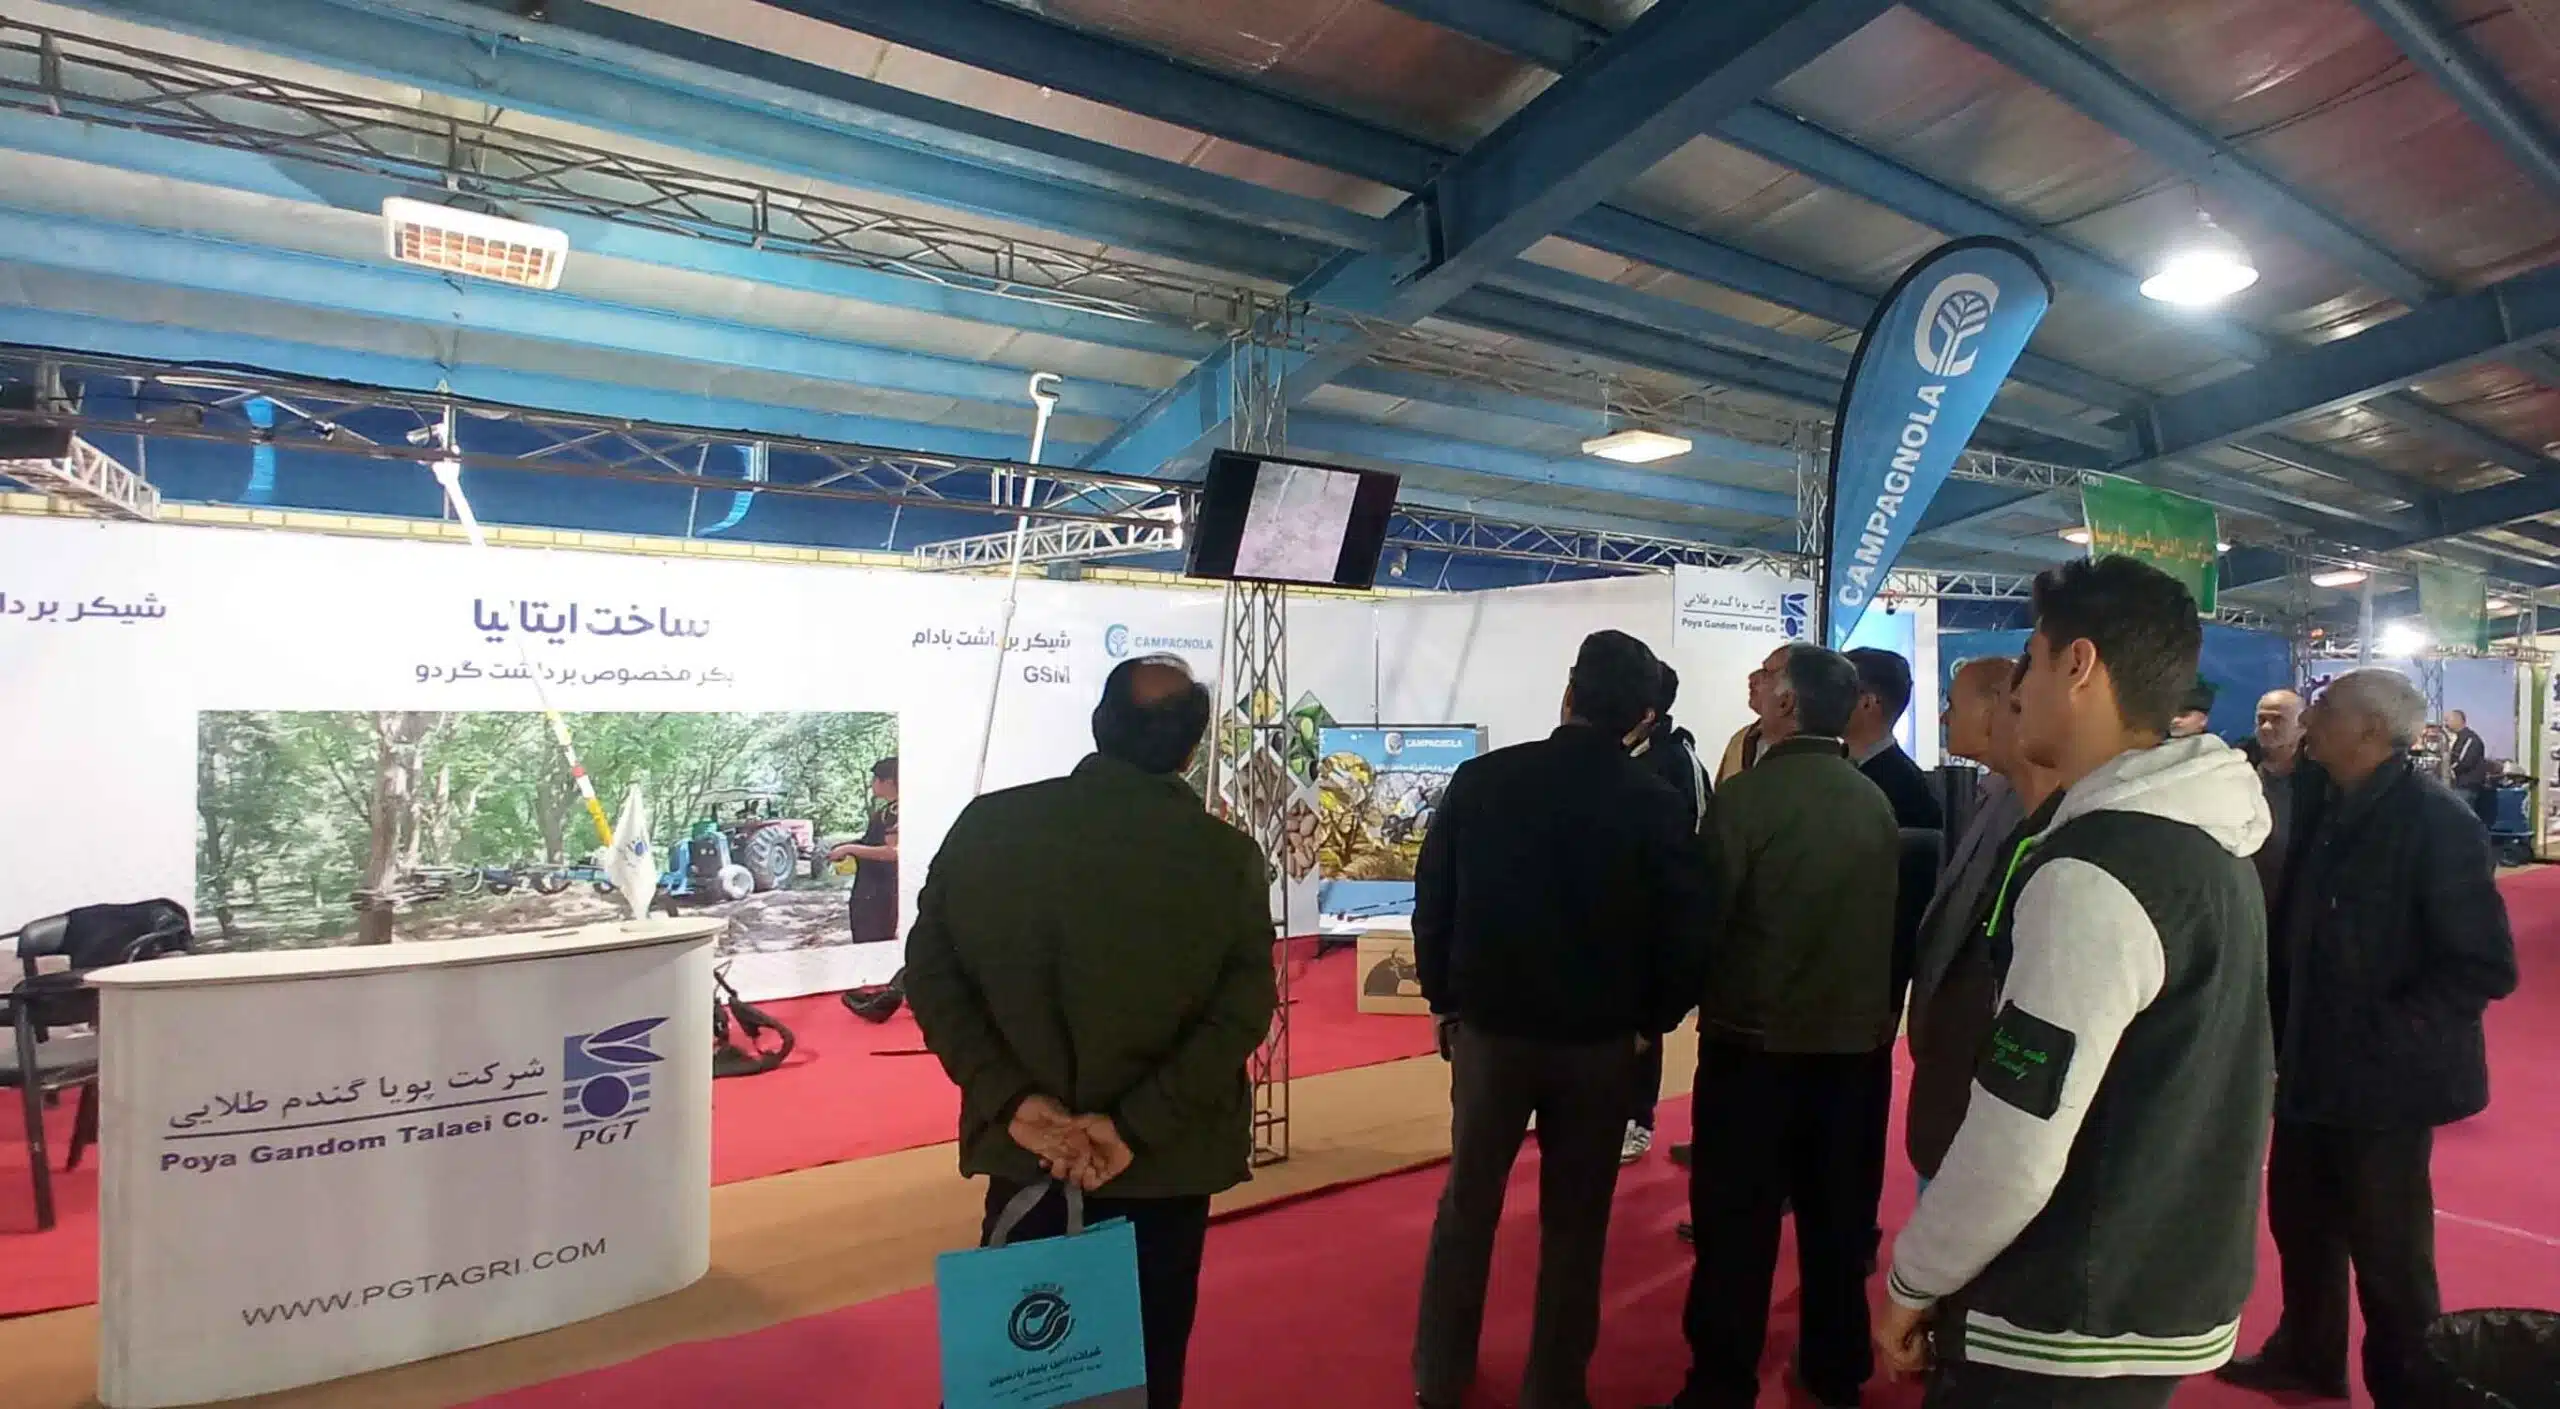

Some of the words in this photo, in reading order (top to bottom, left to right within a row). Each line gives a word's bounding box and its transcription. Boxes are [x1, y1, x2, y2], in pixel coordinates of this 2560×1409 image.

[1838, 384, 1946, 607] CAMPAGNOLA
[65, 592, 166, 625] شیکر
[473, 598, 578, 645] ایتایا
[586, 604, 710, 638] ساخت
[1681, 617, 1703, 630] Poya
[1704, 620, 1738, 631] Gandom
[912, 627, 952, 651] بادام
[956, 626, 1019, 651] براشت
[1023, 629, 1071, 655] شیکر
[1133, 635, 1214, 650] CAMPAGNOLA
[415, 660, 483, 684] گردو
[582, 664, 691, 685] مخصوص
[1023, 666, 1071, 684] GSM
[379, 1076, 432, 1104] پویا
[448, 1058, 545, 1092] شرکت
[169, 1091, 269, 1130] طلایی
[281, 1078, 367, 1119] گندم
[160, 1152, 238, 1174] Poya
[250, 1133, 387, 1165] Gandom
[396, 1115, 493, 1144] Talaei
[503, 1108, 550, 1130] Co.
[574, 1119, 640, 1151] PGT
[241, 1237, 607, 1328] WWW.PGTAGRI.COM
